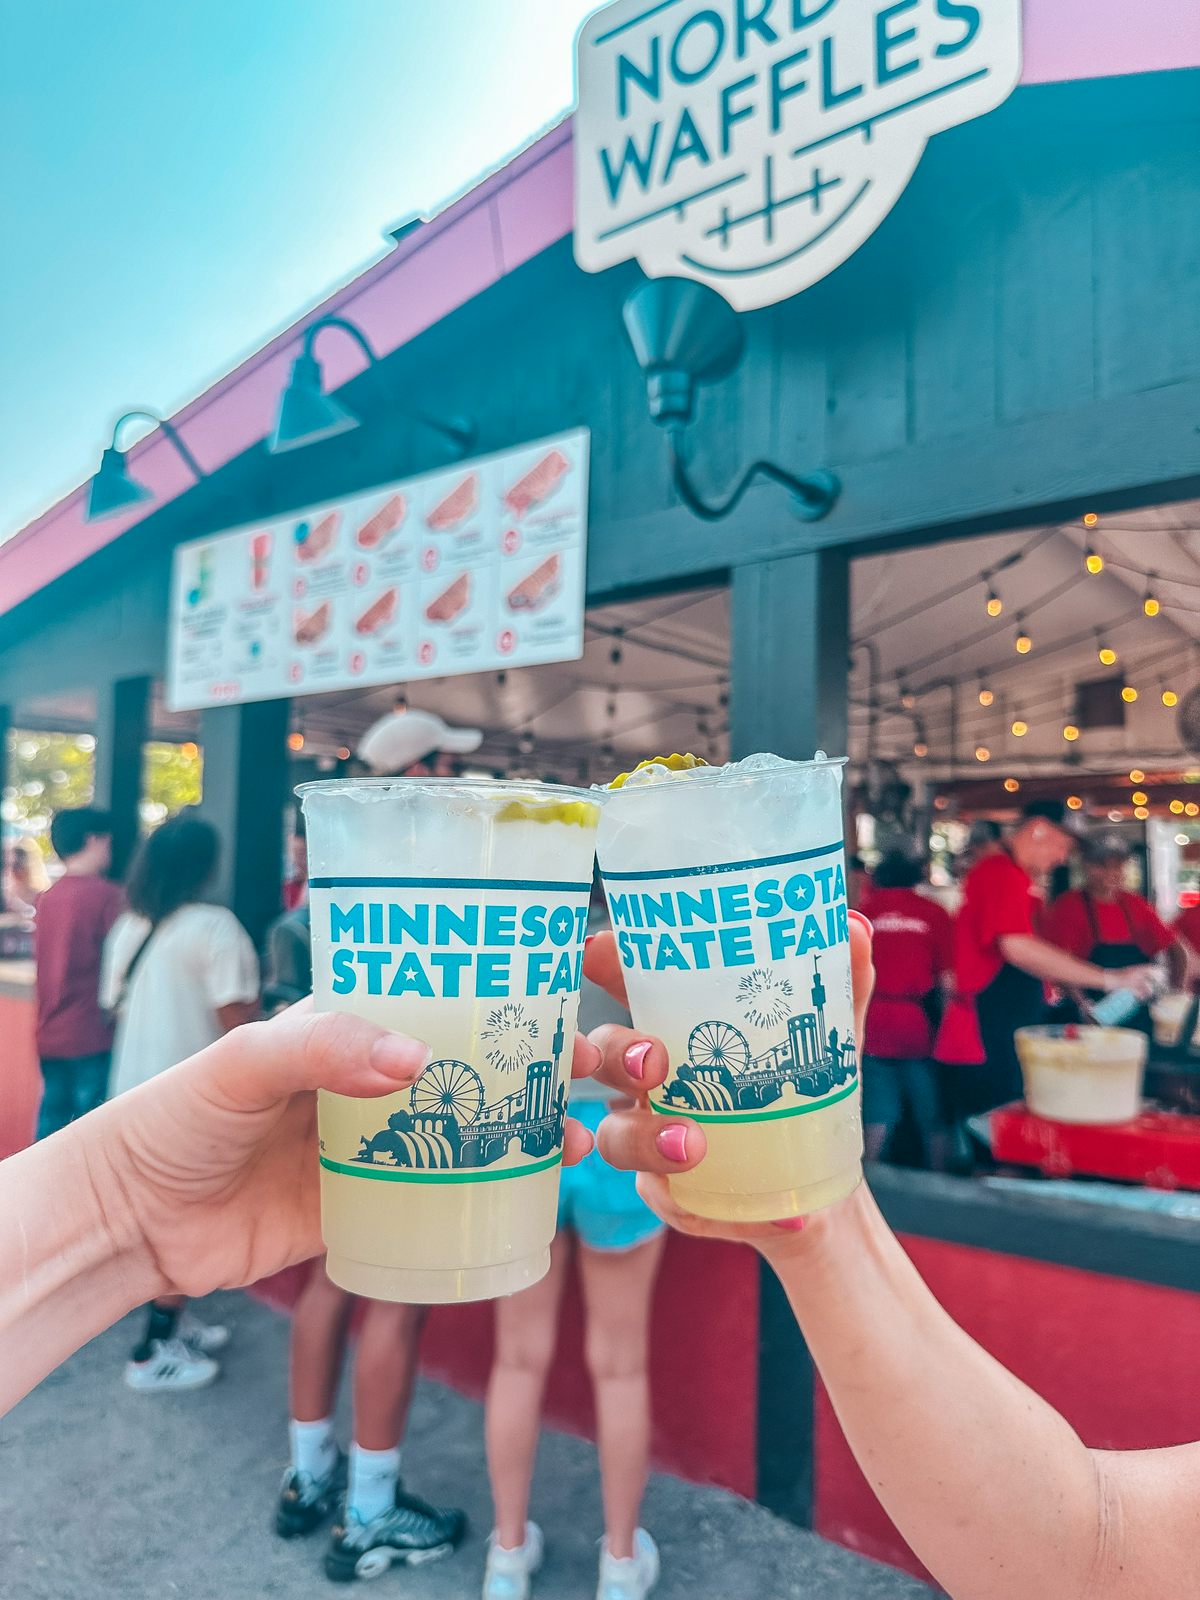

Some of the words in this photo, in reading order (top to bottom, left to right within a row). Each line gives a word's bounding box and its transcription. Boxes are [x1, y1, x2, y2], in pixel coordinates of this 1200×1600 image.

[600, 0, 981, 203] WAFFLES
[330, 903, 587, 946] MINNESOT
[609, 864, 846, 928] MINNESOTA
[619, 925, 755, 971] STATE
[767, 902, 849, 961] FAIR
[332, 949, 511, 998] STATE
[526, 951, 584, 997] FAI
